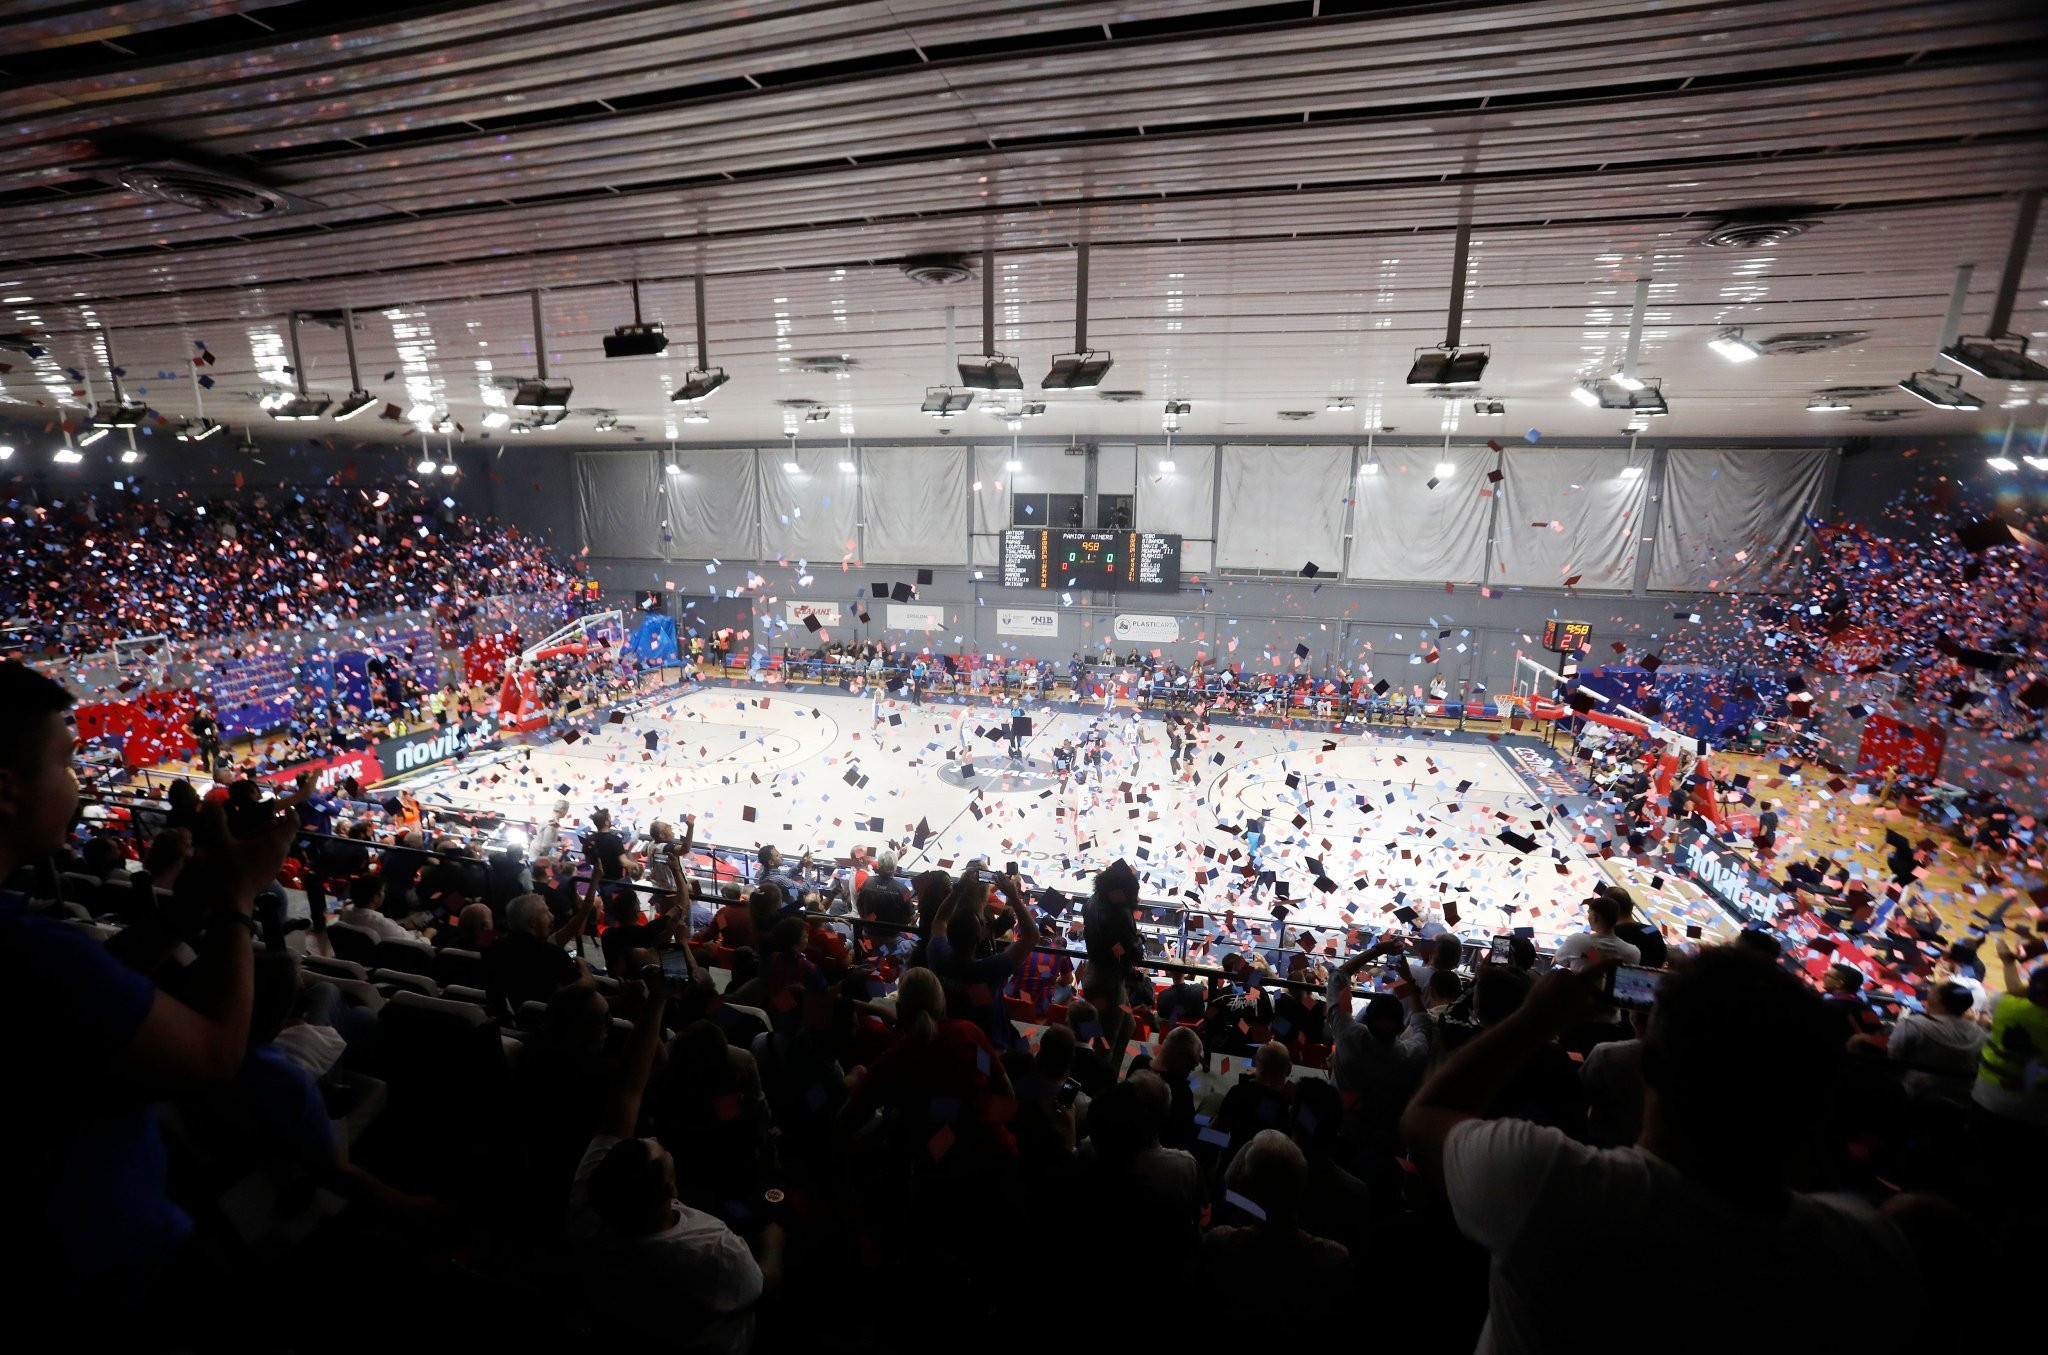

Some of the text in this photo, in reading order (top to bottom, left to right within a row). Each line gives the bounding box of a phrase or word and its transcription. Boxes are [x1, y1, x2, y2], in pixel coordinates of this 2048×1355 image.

[1069, 553, 1075, 561] 0
[1107, 554, 1113, 562] 0
[1560, 634, 1584, 648] 21
